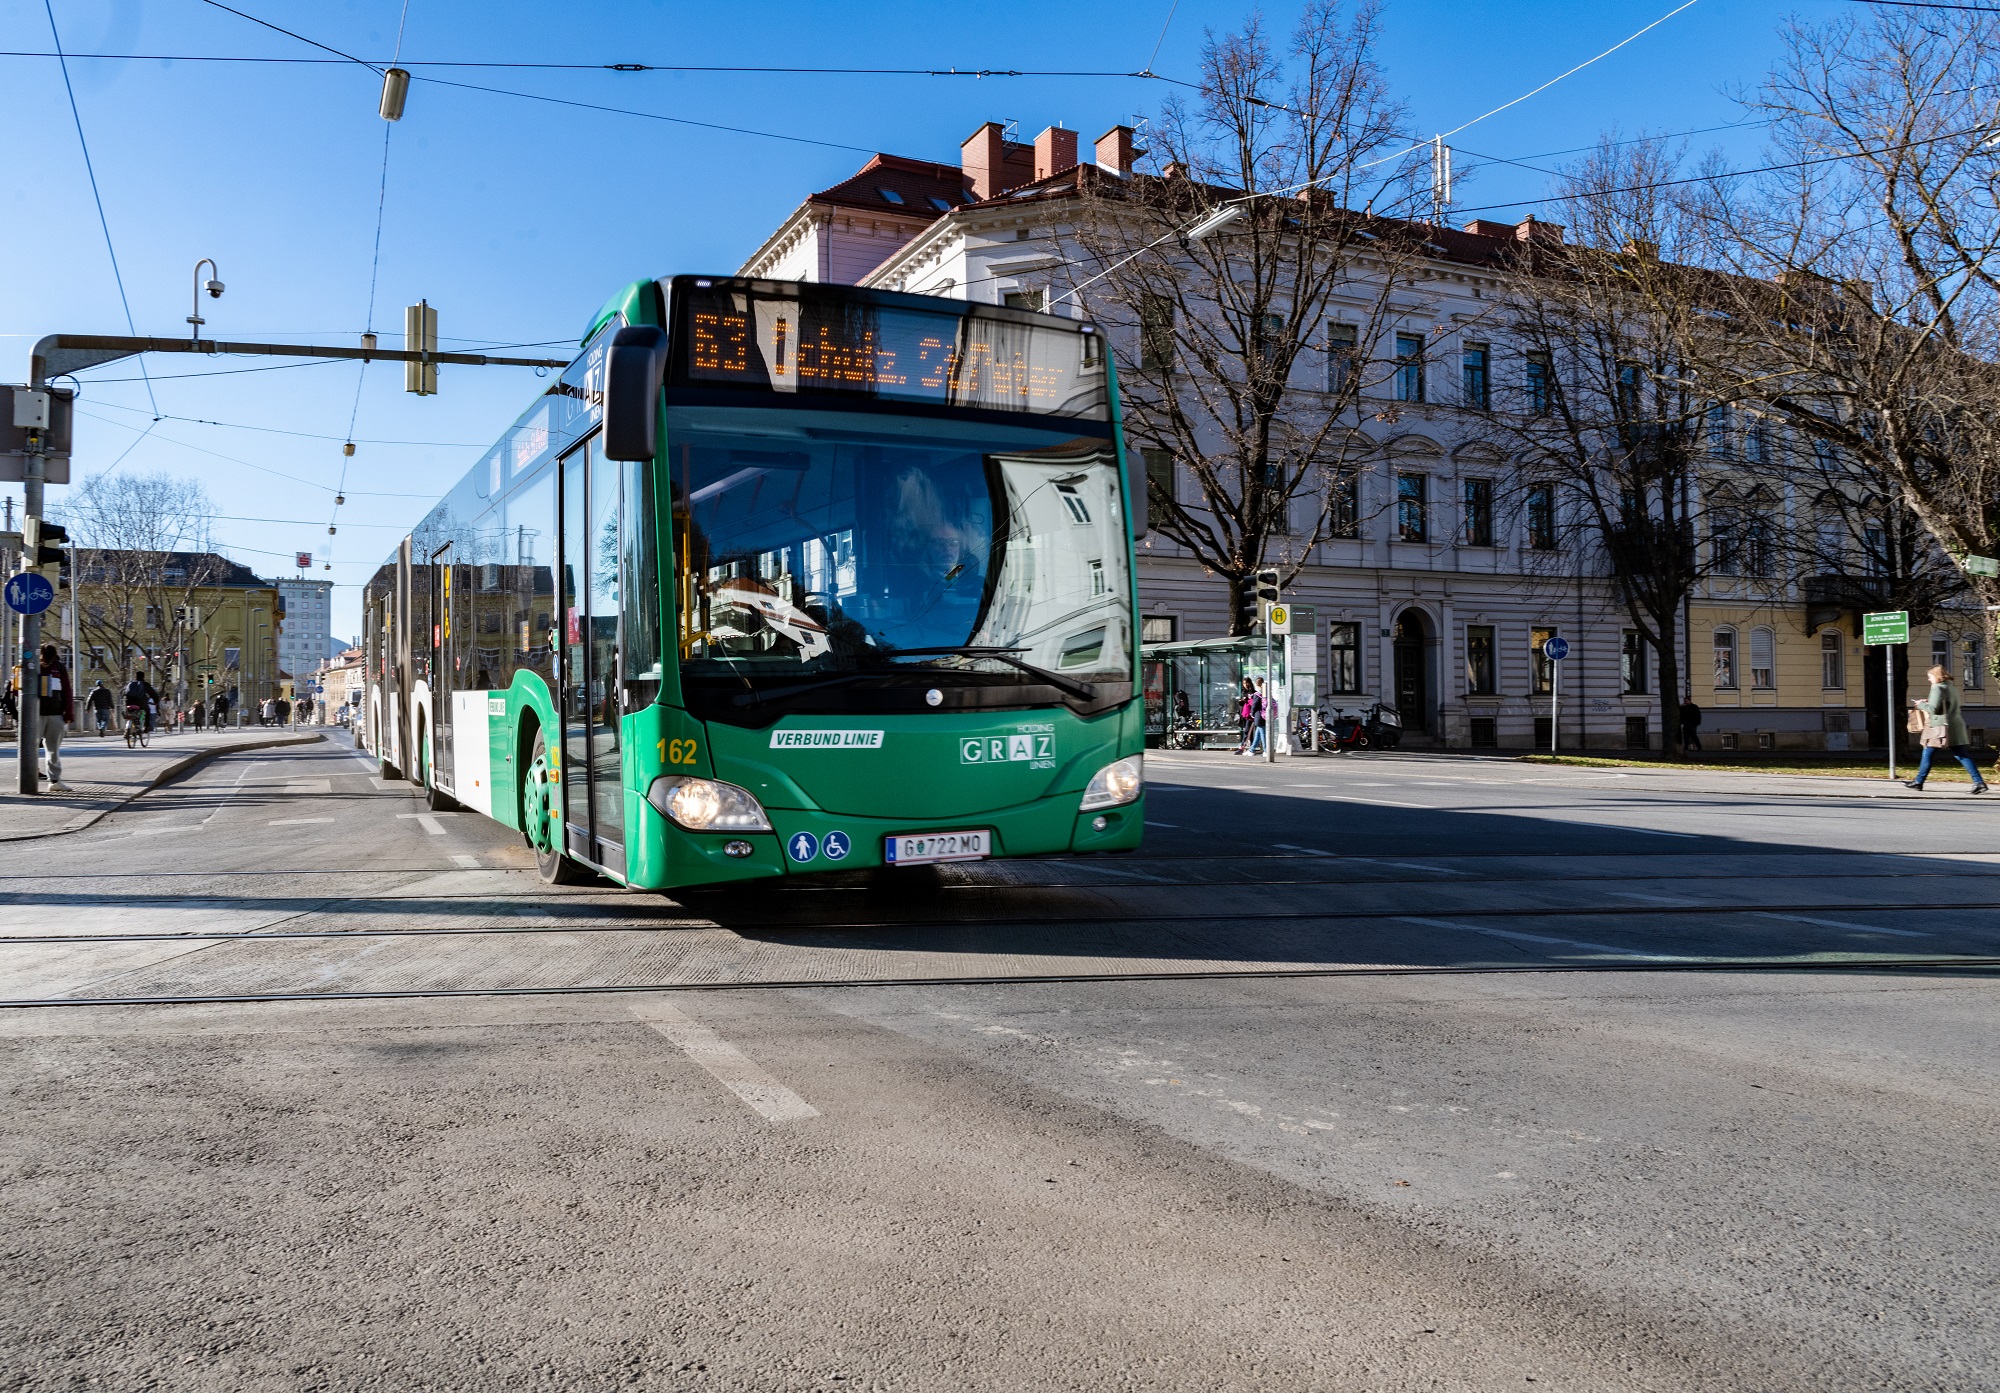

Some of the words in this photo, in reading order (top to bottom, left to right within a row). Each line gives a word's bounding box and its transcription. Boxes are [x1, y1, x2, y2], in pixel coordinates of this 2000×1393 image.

[696, 314, 745, 370] 63
[1275, 610, 1283, 621] H
[1144, 698, 1164, 706] ELVIS
[1017, 723, 1055, 733] HOLDING
[777, 733, 841, 746] VERBUND
[843, 733, 879, 746] LINIE
[656, 737, 697, 765] 162
[963, 737, 1051, 762] GRAZ
[1030, 760, 1056, 770] LINIEN
[904, 839, 914, 857] G
[927, 837, 956, 855] 722
